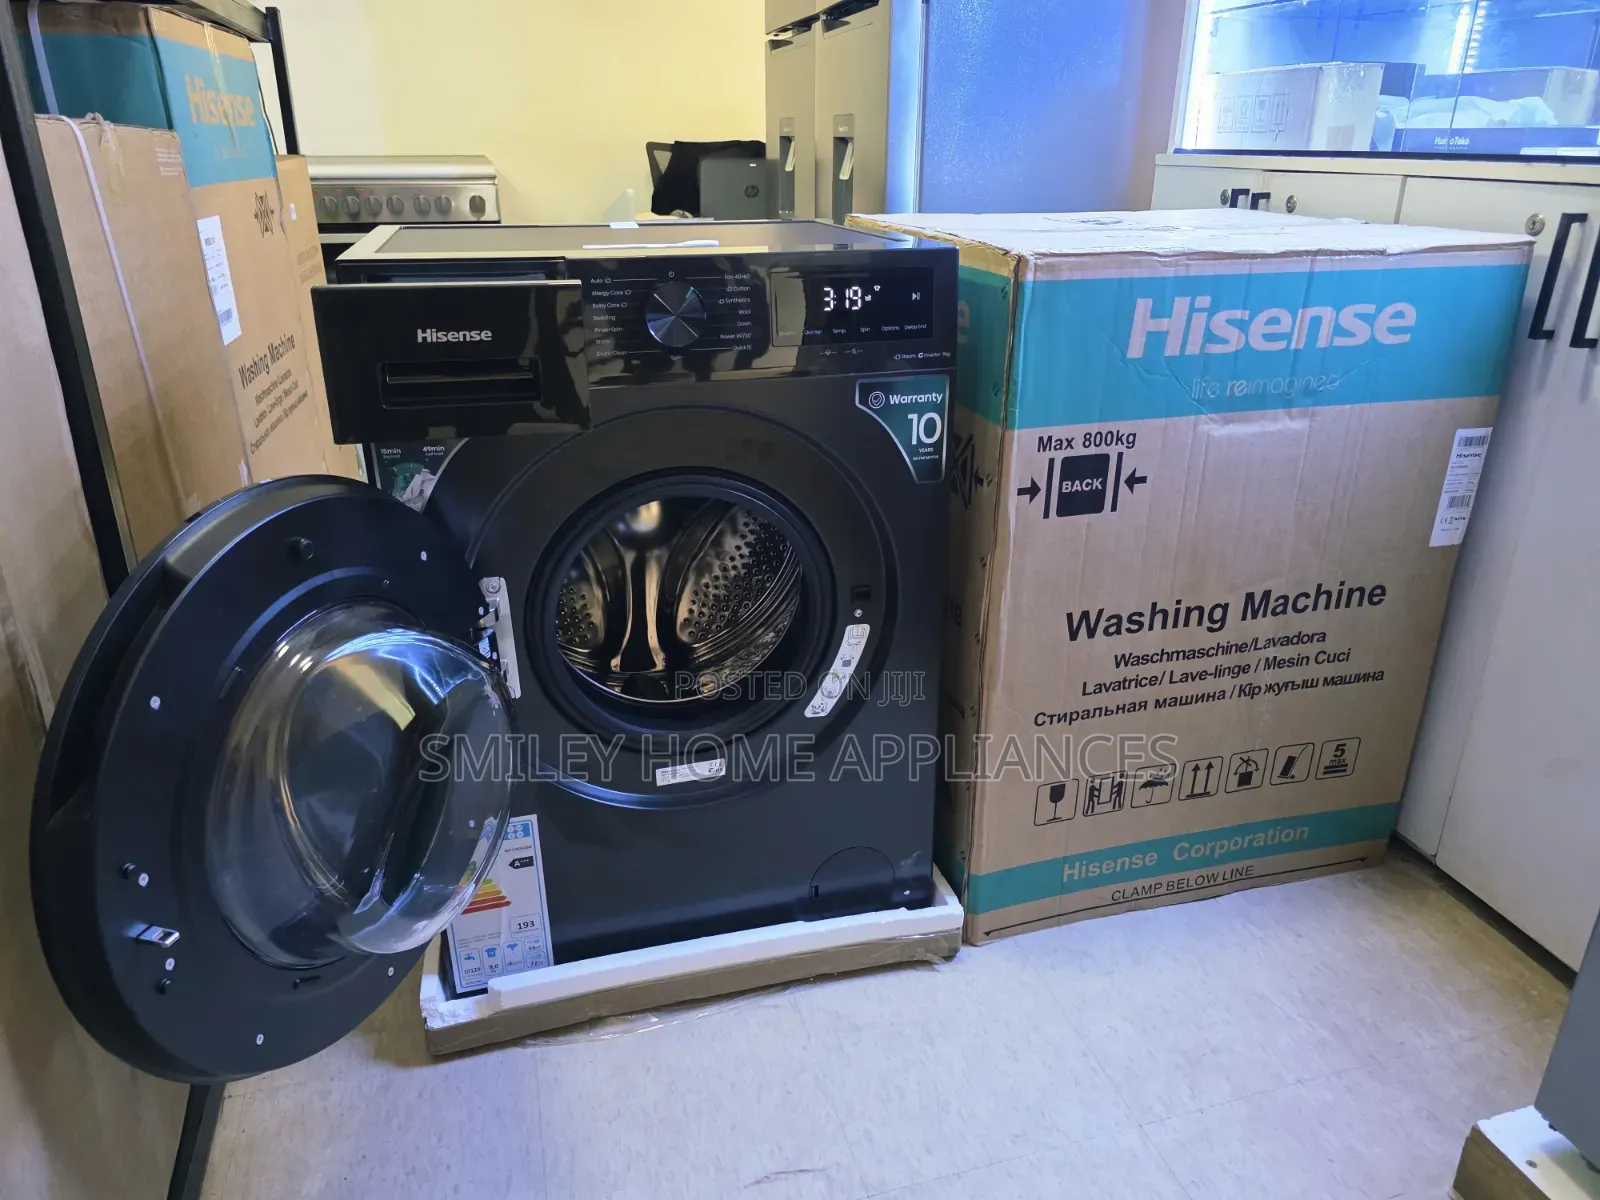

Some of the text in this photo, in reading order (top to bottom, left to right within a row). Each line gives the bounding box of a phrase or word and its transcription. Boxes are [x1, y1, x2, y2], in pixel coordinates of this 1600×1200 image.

[185, 74, 256, 128] Hisense
[416, 327, 493, 344] Hisense
[881, 323, 900, 332] Options
[904, 322, 918, 331] Delay
[1126, 295, 1417, 359] Hisense
[238, 352, 270, 390] Washing
[267, 334, 296, 366] Machine
[888, 391, 944, 405] Warranty
[1191, 372, 1342, 400] life reimagined
[907, 411, 942, 446] 10
[1037, 430, 1137, 454] Max 800kg
[423, 445, 445, 453] 49min
[1061, 477, 1104, 494] BACK
[1065, 580, 1388, 643] Washing Machine
[1113, 631, 1327, 670] Waschmaschine/Lavadora
[1168, 660, 1252, 686] Lave-linge
[1263, 653, 1310, 672] Mesin
[1313, 648, 1352, 665] Cuci
[1033, 700, 1149, 727] Стиральная
[1153, 686, 1227, 710] машина
[1322, 669, 1386, 688] машина
[1329, 758, 1348, 766] max
[1332, 743, 1348, 759] 5
[1062, 823, 1311, 884] Hisense Corporation
[1111, 864, 1256, 902] CLAMP BELOW LINE
[517, 920, 536, 930] 193
